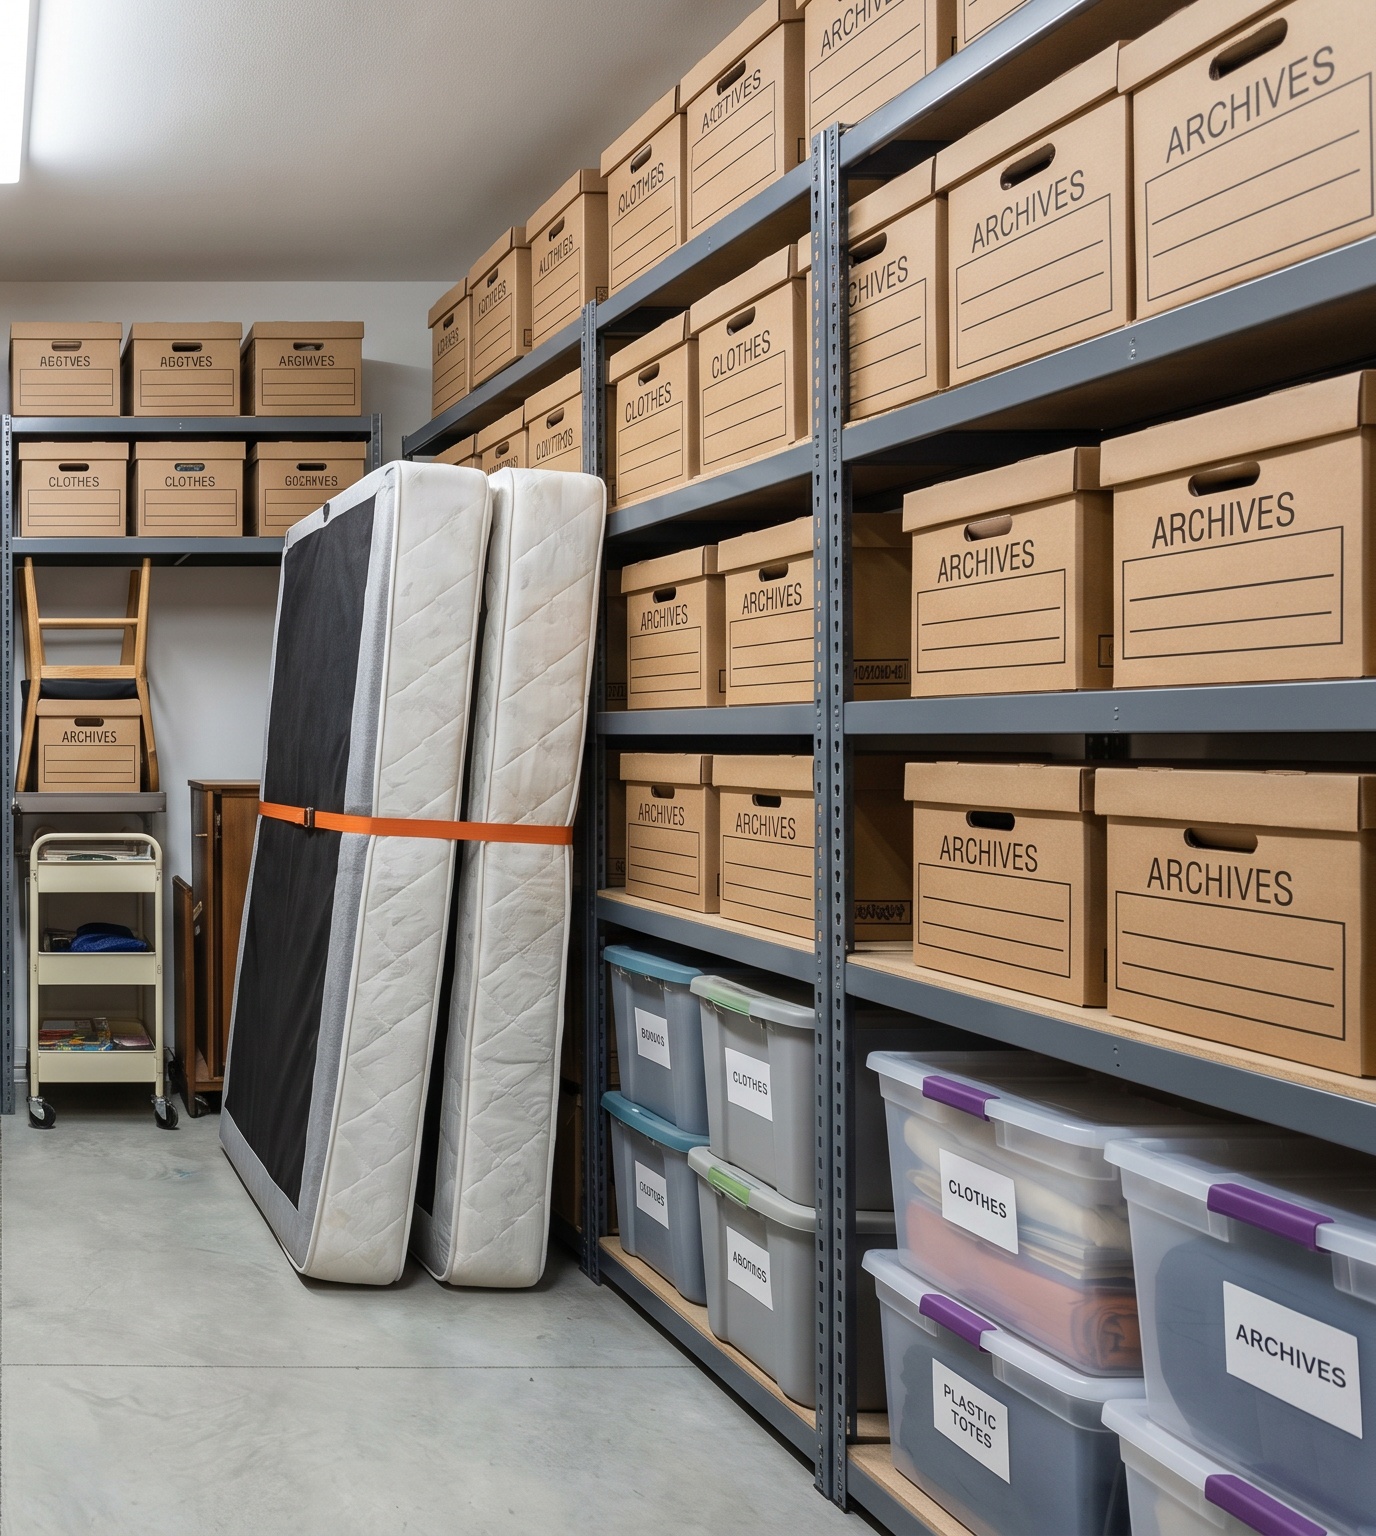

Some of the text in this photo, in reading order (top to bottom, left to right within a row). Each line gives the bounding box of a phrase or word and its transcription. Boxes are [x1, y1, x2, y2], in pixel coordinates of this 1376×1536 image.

[1166, 45, 1335, 163] ARCHIVES
[971, 169, 1085, 254] ARCHIVES
[848, 255, 908, 309] CHIVES
[712, 329, 771, 379] CLOTHES
[625, 381, 672, 423] CLOTHES
[49, 476, 100, 488] CLOTHES
[165, 476, 215, 488] CLOTHES
[1152, 491, 1295, 549] ARCHIVES
[937, 540, 1035, 584] ARCHIVES
[640, 603, 688, 632] ARCHIVES
[742, 583, 802, 615] ARCHIVES
[62, 730, 117, 743] ARCHIVES
[638, 802, 685, 826] ARCHIVES
[735, 813, 796, 840] ARCHIVES
[940, 836, 1038, 873] ARCHIVES
[1147, 857, 1293, 907] ARCHIVES
[733, 1071, 768, 1095] CLOTHES
[948, 1178, 1007, 1220] CLOTHES
[1235, 1324, 1345, 1389] ARCHIVES
[943, 1382, 997, 1433] PLASTIC
[951, 1408, 993, 1450] TOTES
